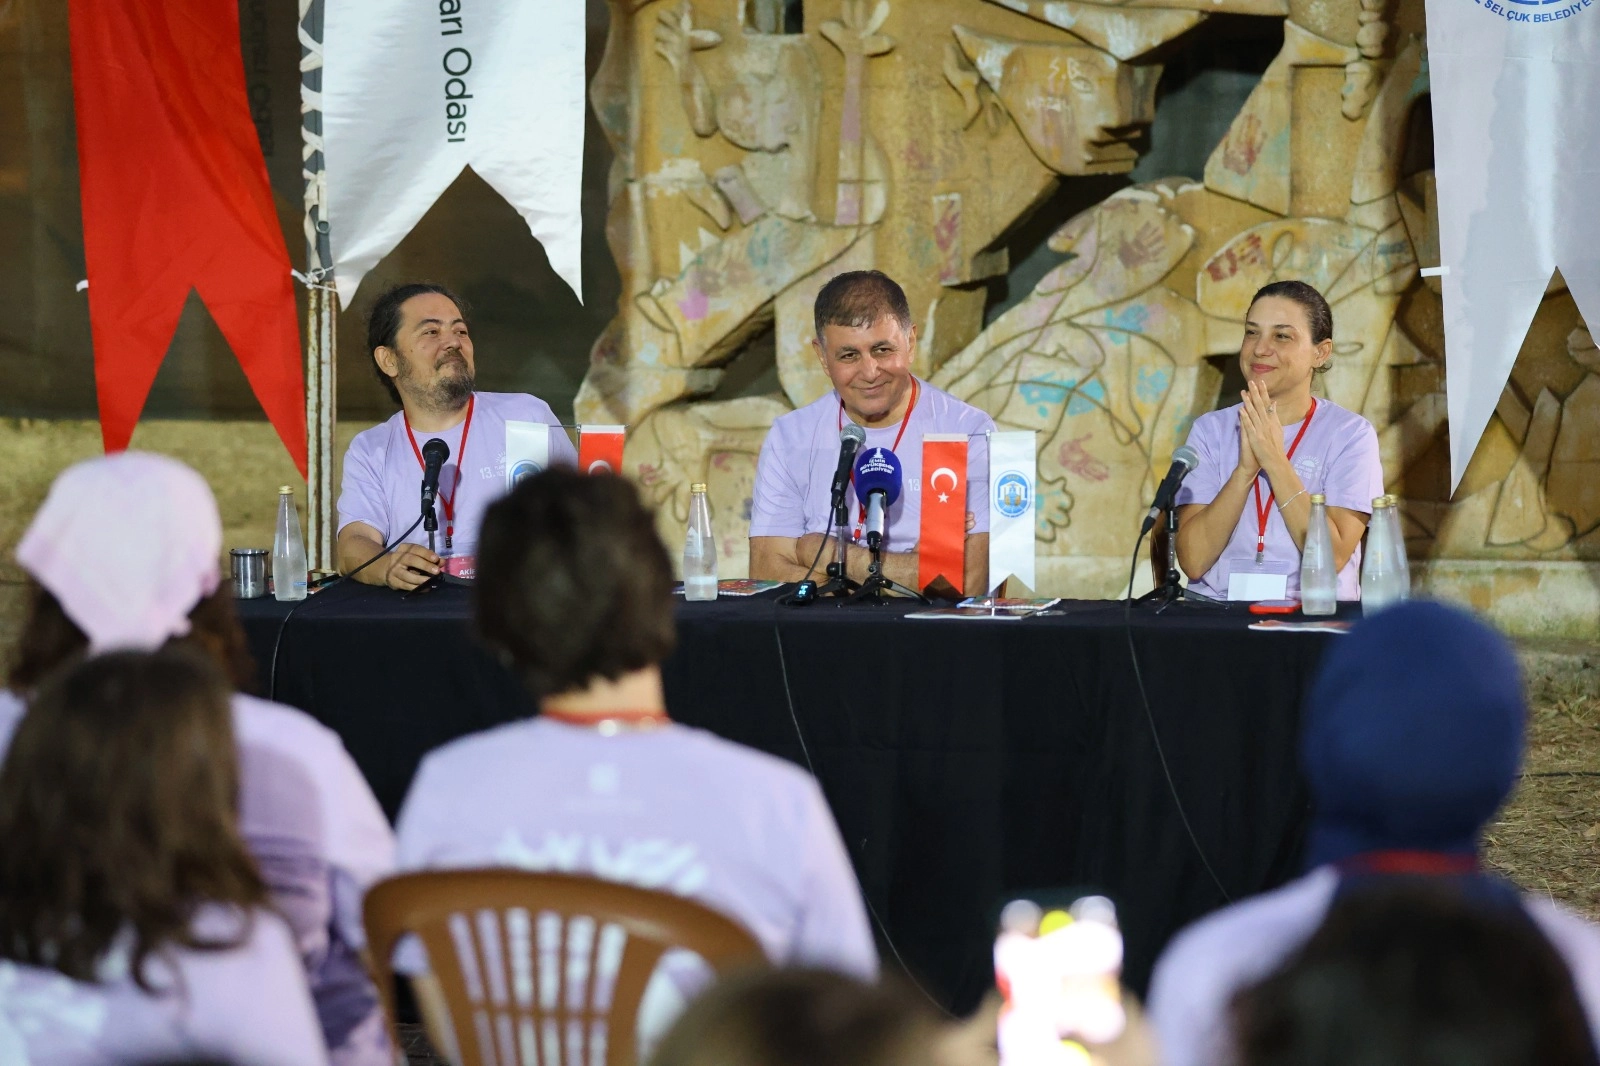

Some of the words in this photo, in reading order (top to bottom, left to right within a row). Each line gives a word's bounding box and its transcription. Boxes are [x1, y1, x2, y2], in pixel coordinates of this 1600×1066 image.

[1484, 0, 1531, 23] SELÇUK
[1533, 0, 1596, 23] BELEDİYE
[443, 47, 474, 143] Odası
